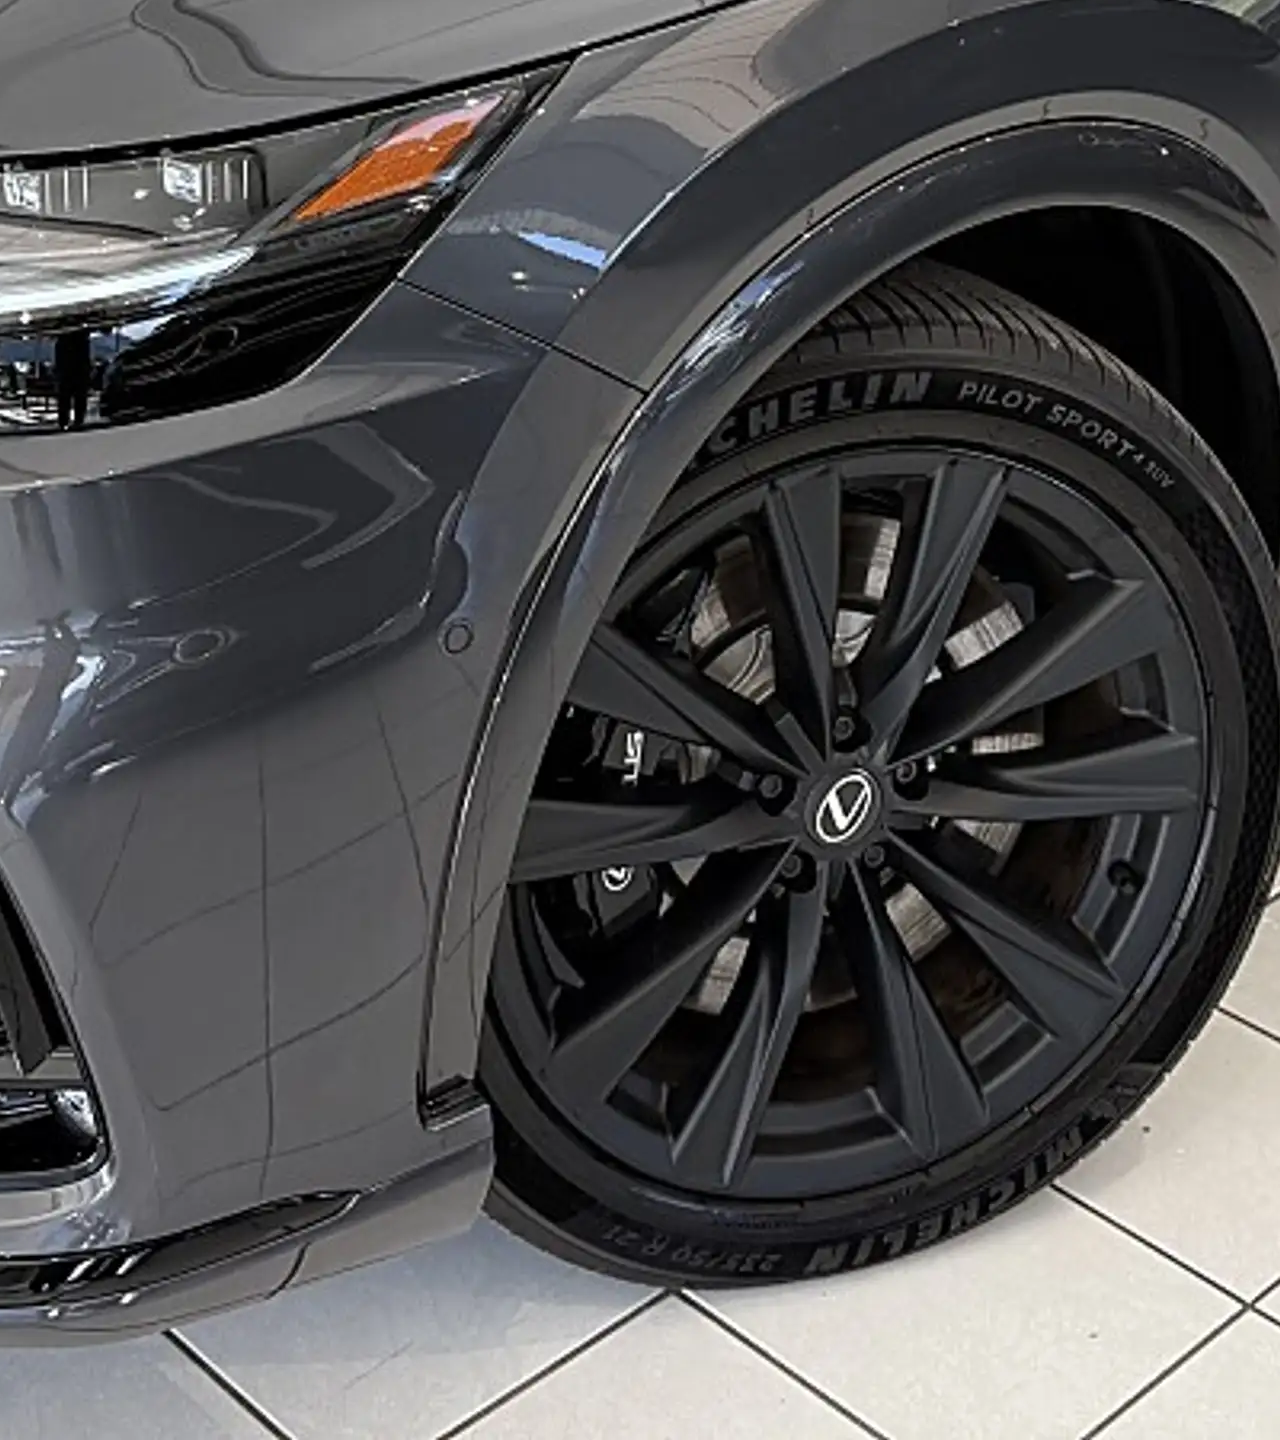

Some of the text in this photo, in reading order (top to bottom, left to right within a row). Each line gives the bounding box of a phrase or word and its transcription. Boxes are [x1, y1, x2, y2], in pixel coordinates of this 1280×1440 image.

[707, 371, 933, 453] CHELIN
[958, 380, 1044, 413] PILOT
[1046, 403, 1135, 457] SPORT
[802, 1126, 1085, 1274] MICHELIN
